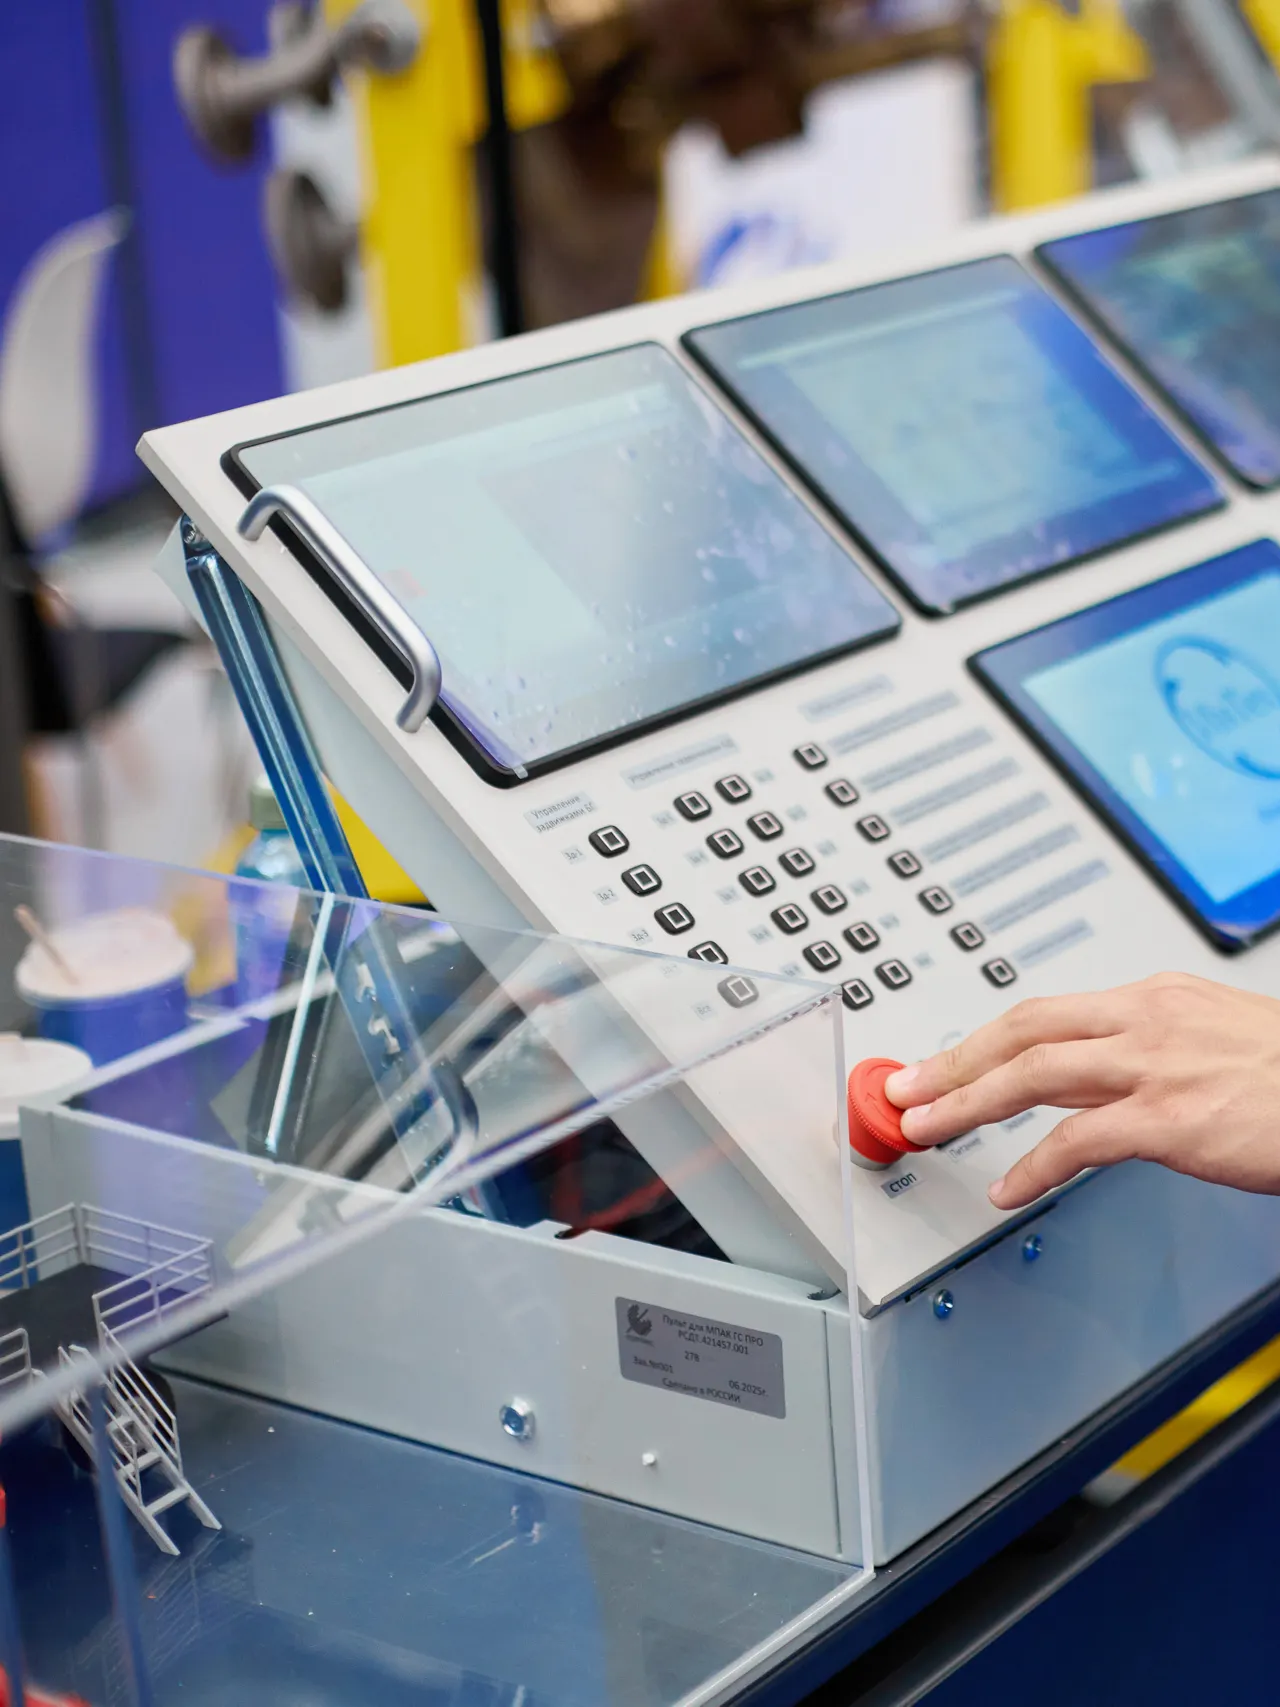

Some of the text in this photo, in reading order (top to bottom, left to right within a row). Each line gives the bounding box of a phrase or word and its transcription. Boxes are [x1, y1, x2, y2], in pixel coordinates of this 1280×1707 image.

[530, 796, 580, 819] Управление
[889, 1172, 917, 1193] СТОП
[662, 1314, 764, 1347] Пульт для МПАК ГС ПРО
[706, 1387, 741, 1403] РОССИИ
